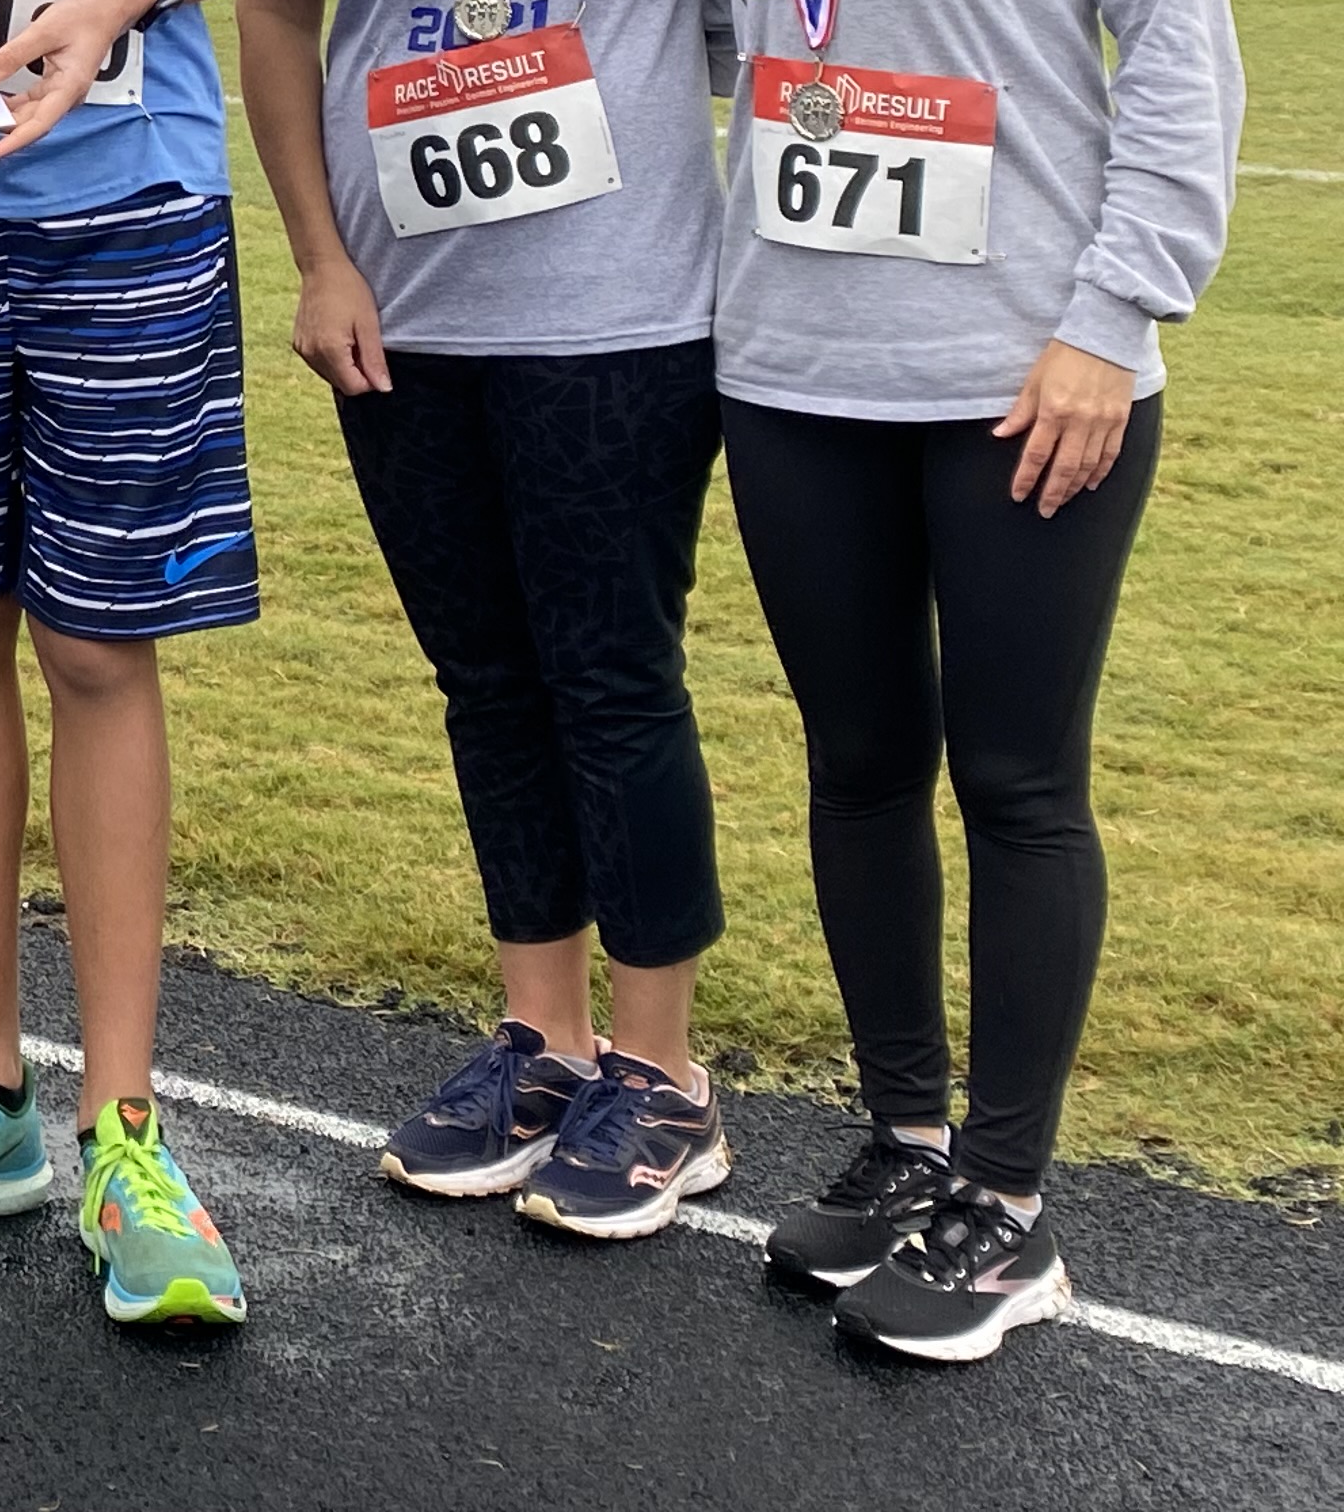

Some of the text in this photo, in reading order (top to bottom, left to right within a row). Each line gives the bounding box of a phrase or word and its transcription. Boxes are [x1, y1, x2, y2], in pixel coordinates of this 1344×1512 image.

[394, 50, 546, 104] RACE RESULT
[862, 92, 951, 121] RESULT
[410, 111, 570, 208] 668
[778, 143, 926, 236] 671
